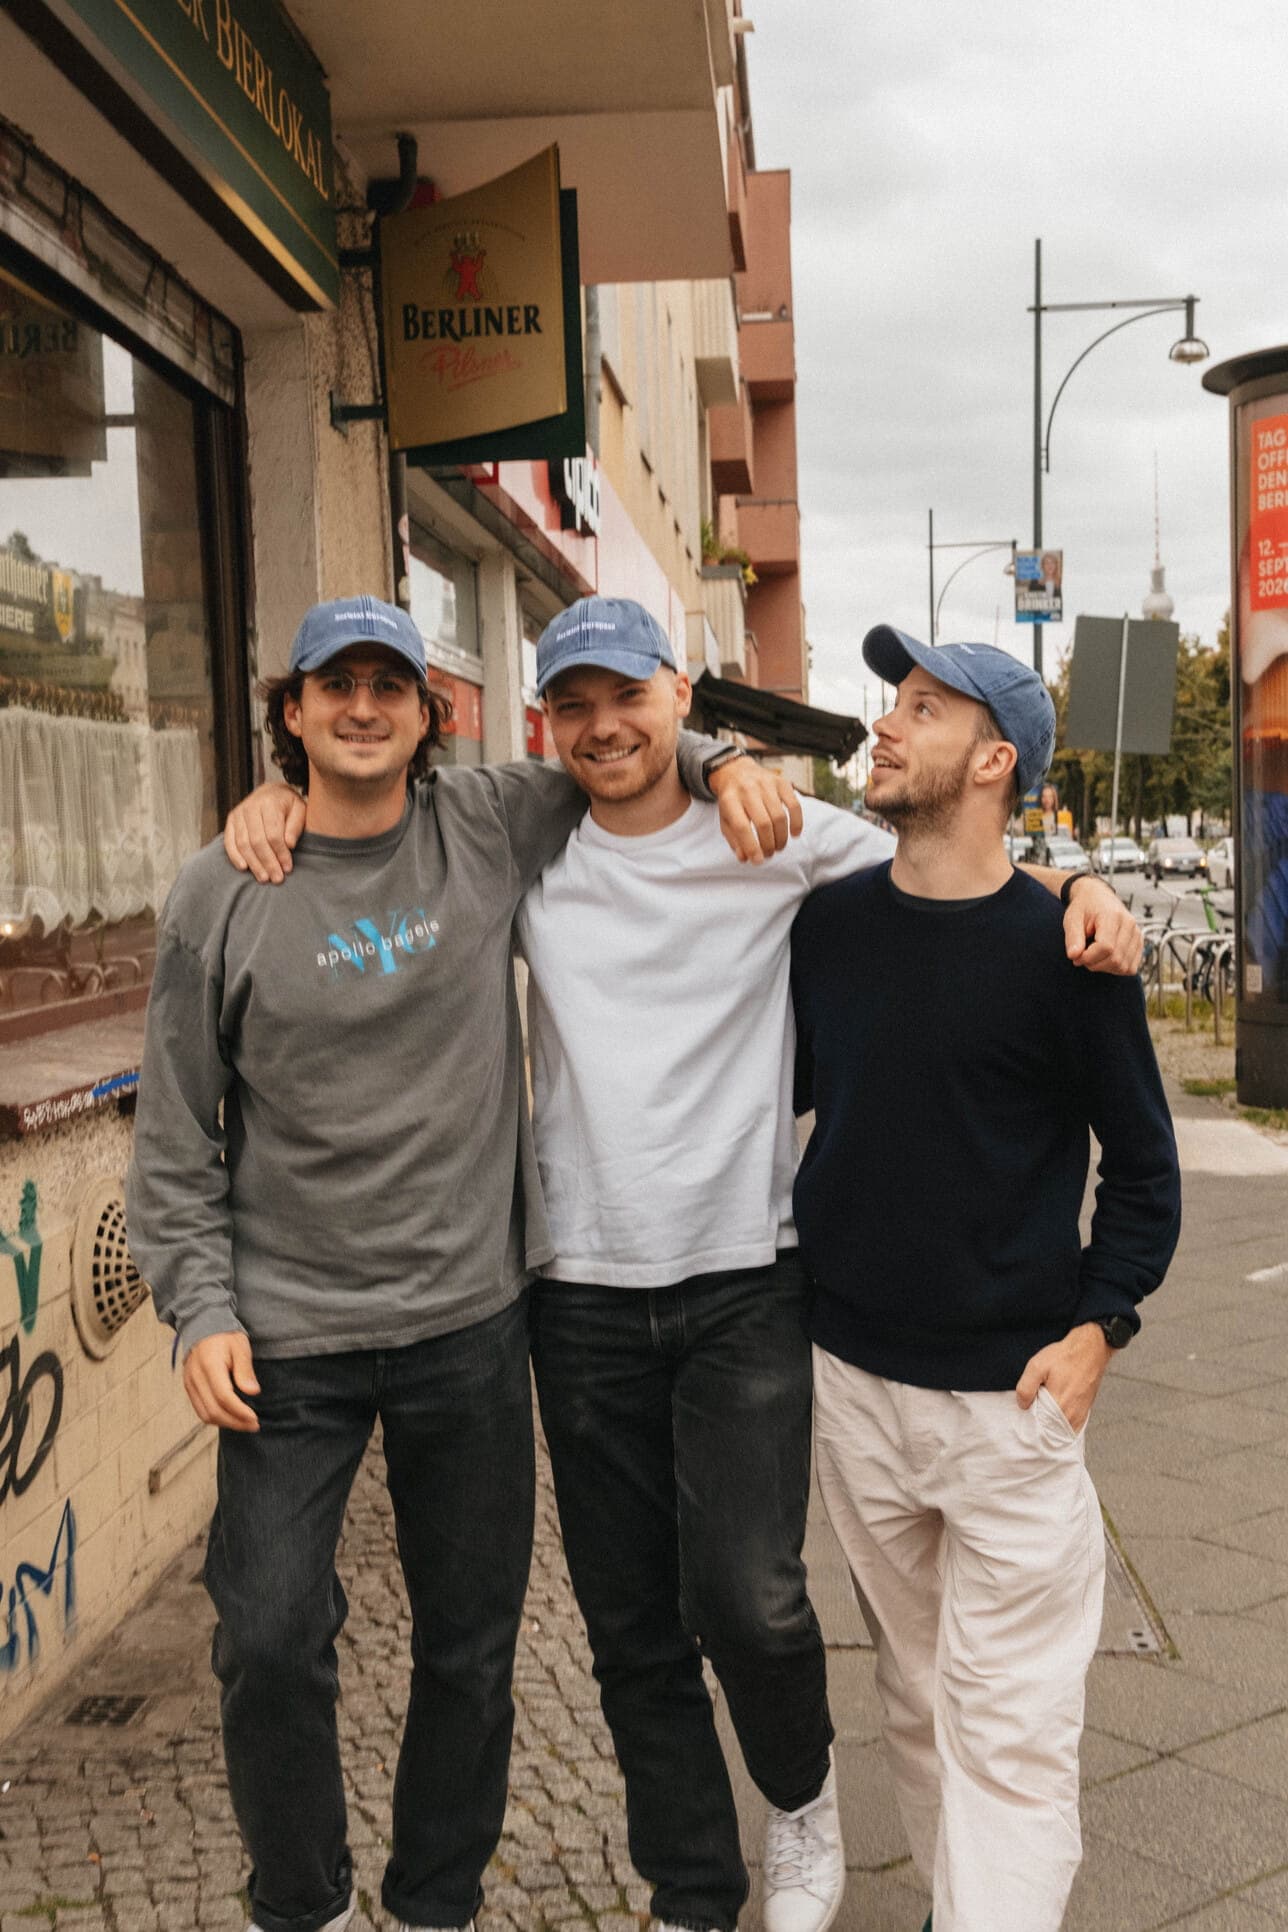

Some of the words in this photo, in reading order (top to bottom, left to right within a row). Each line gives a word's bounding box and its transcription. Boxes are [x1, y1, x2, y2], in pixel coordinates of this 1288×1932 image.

[216, 0, 329, 200] BIERLOKAL
[402, 303, 543, 342] BERLINER
[1257, 428, 1287, 449] TAG
[1256, 448, 1288, 471] OFF
[1257, 489, 1288, 512] BER
[1257, 538, 1275, 557] 12.
[0, 603, 34, 634] IERE
[317, 936, 376, 969] apollo
